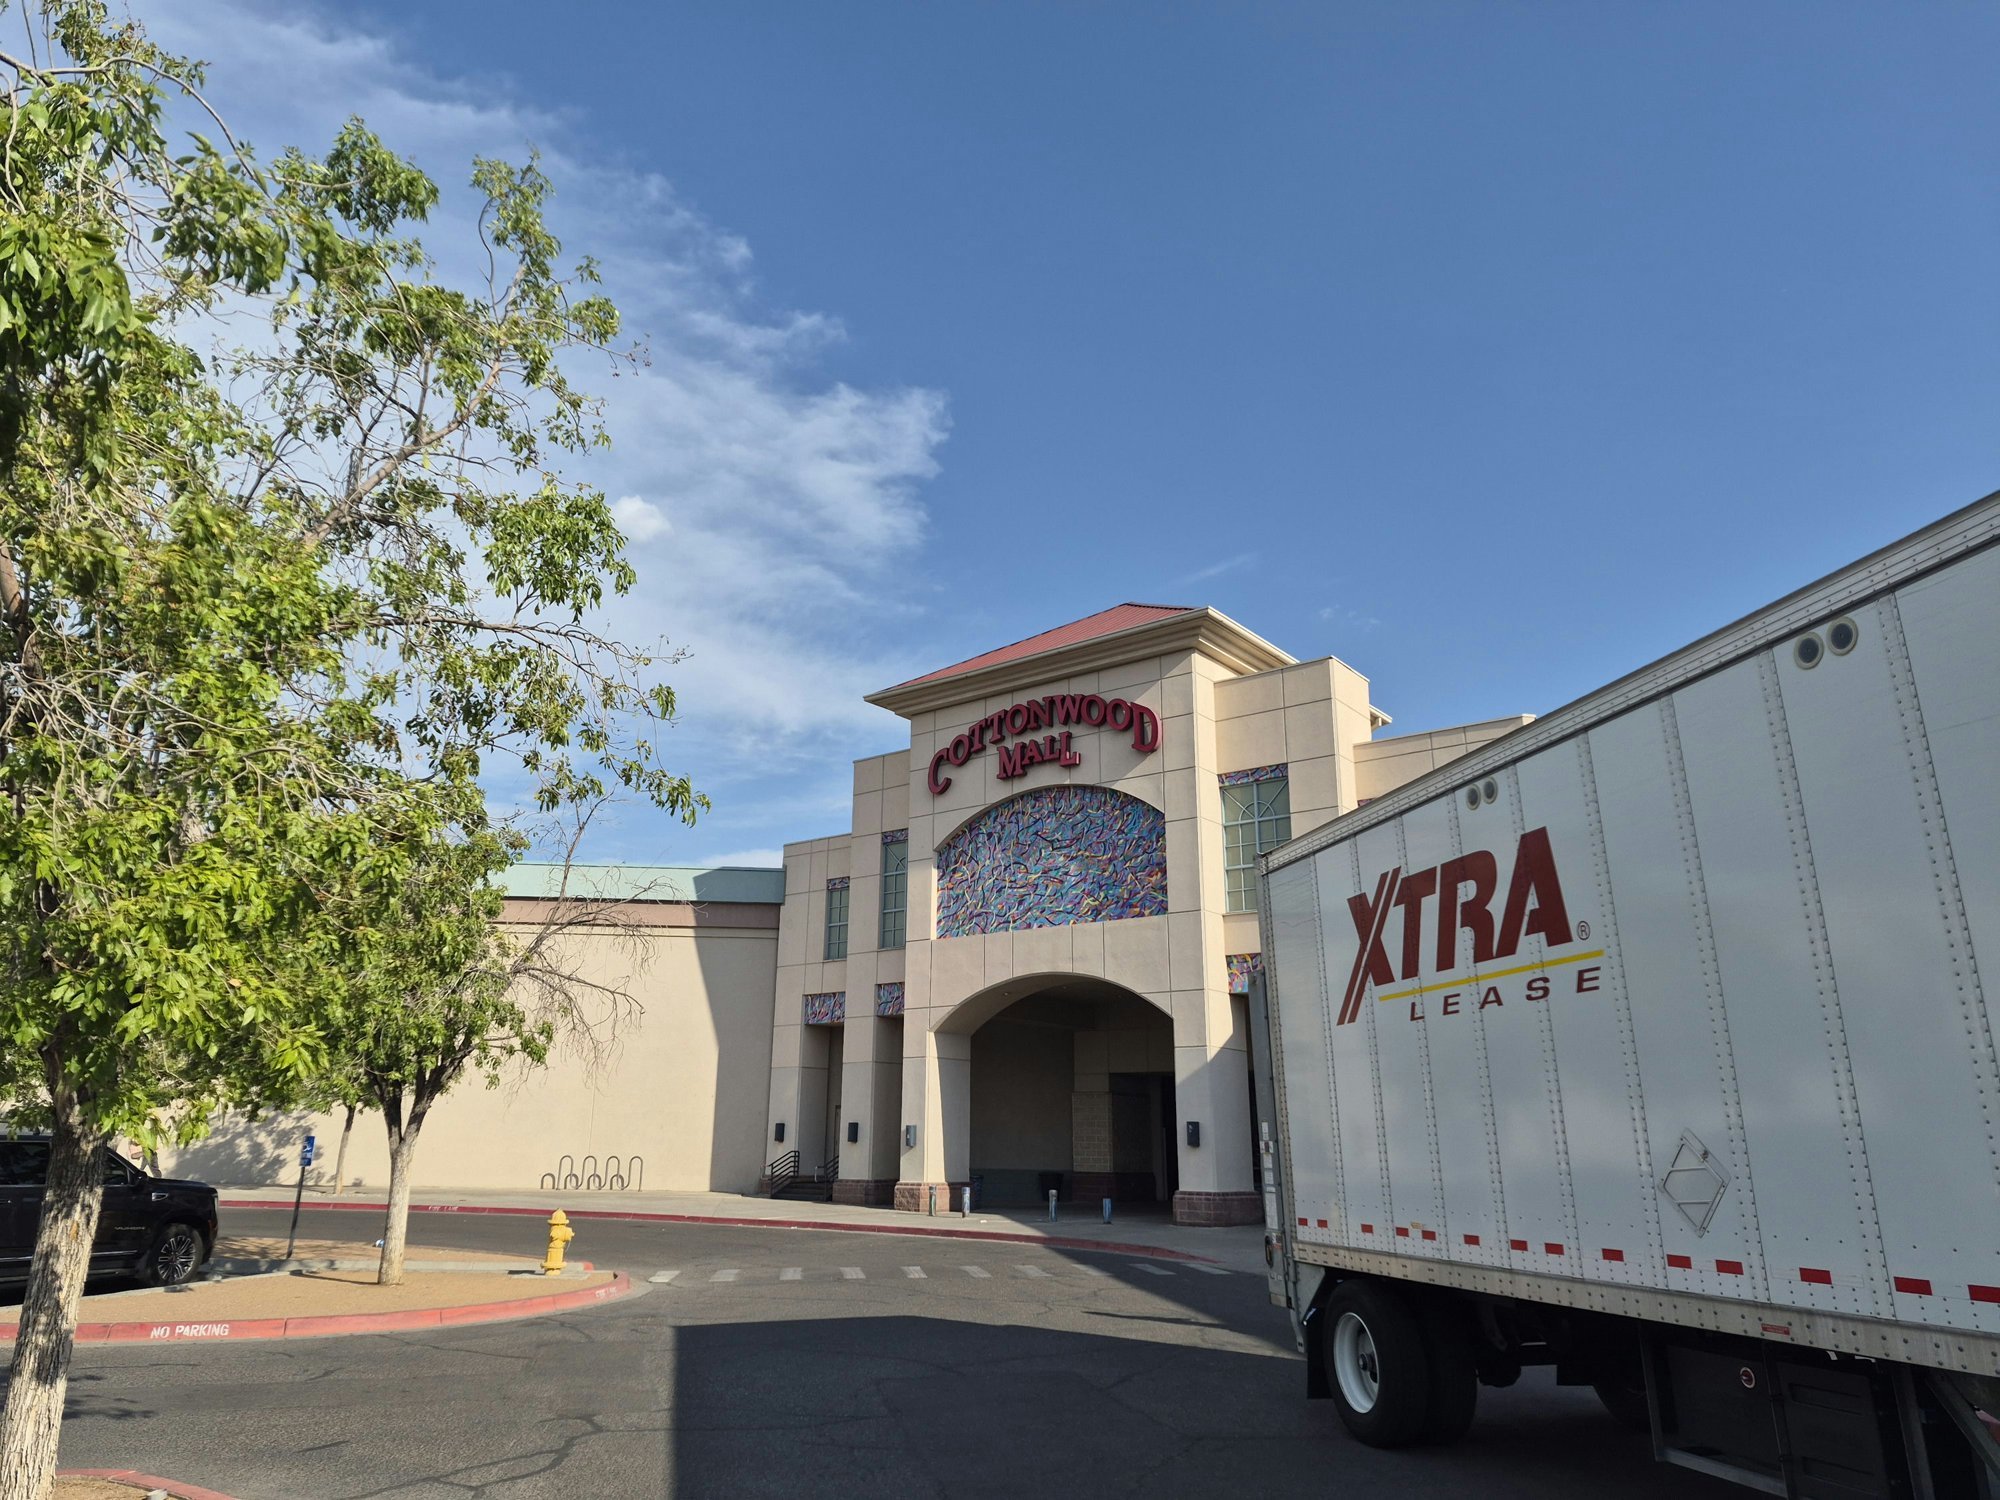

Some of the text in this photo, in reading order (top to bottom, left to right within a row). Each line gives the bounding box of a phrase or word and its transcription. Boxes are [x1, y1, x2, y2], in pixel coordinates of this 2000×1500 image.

[928, 693, 1162, 795] COTTONWOOD
[997, 730, 1081, 780] MALL
[1336, 826, 1574, 1026] XTRA
[1410, 966, 1601, 1022] LEASE
[150, 1323, 230, 1339] NO PARKING
